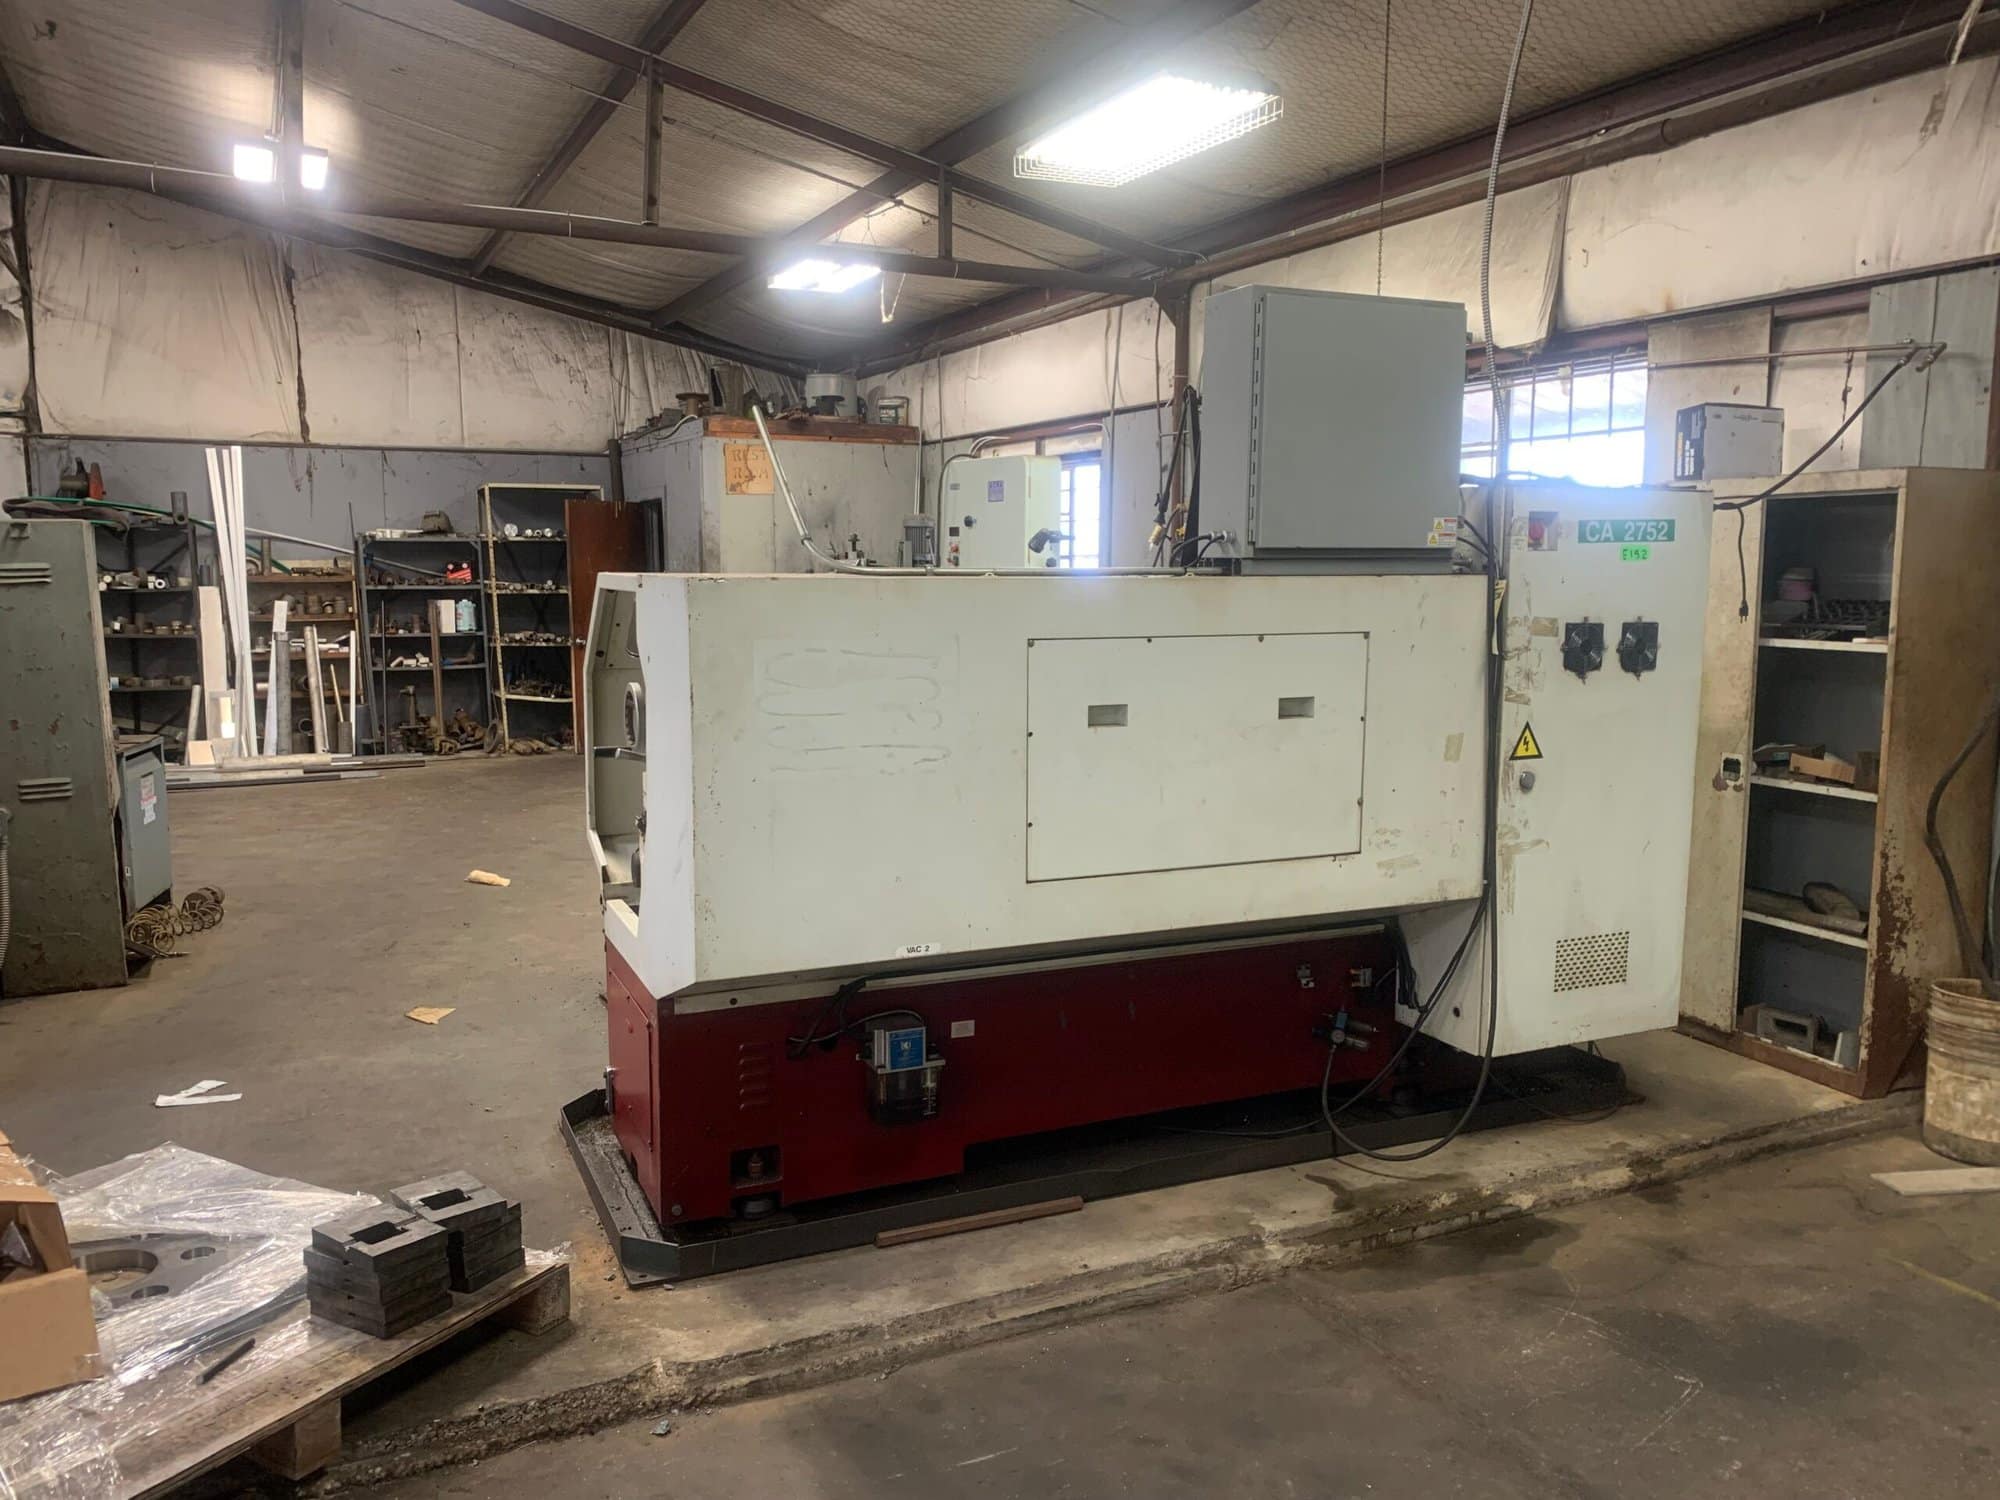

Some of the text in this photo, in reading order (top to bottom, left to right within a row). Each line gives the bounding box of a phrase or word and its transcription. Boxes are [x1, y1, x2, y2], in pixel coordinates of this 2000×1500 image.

[1585, 521, 1668, 542] CA 2752
[906, 945, 922, 953] VAC
